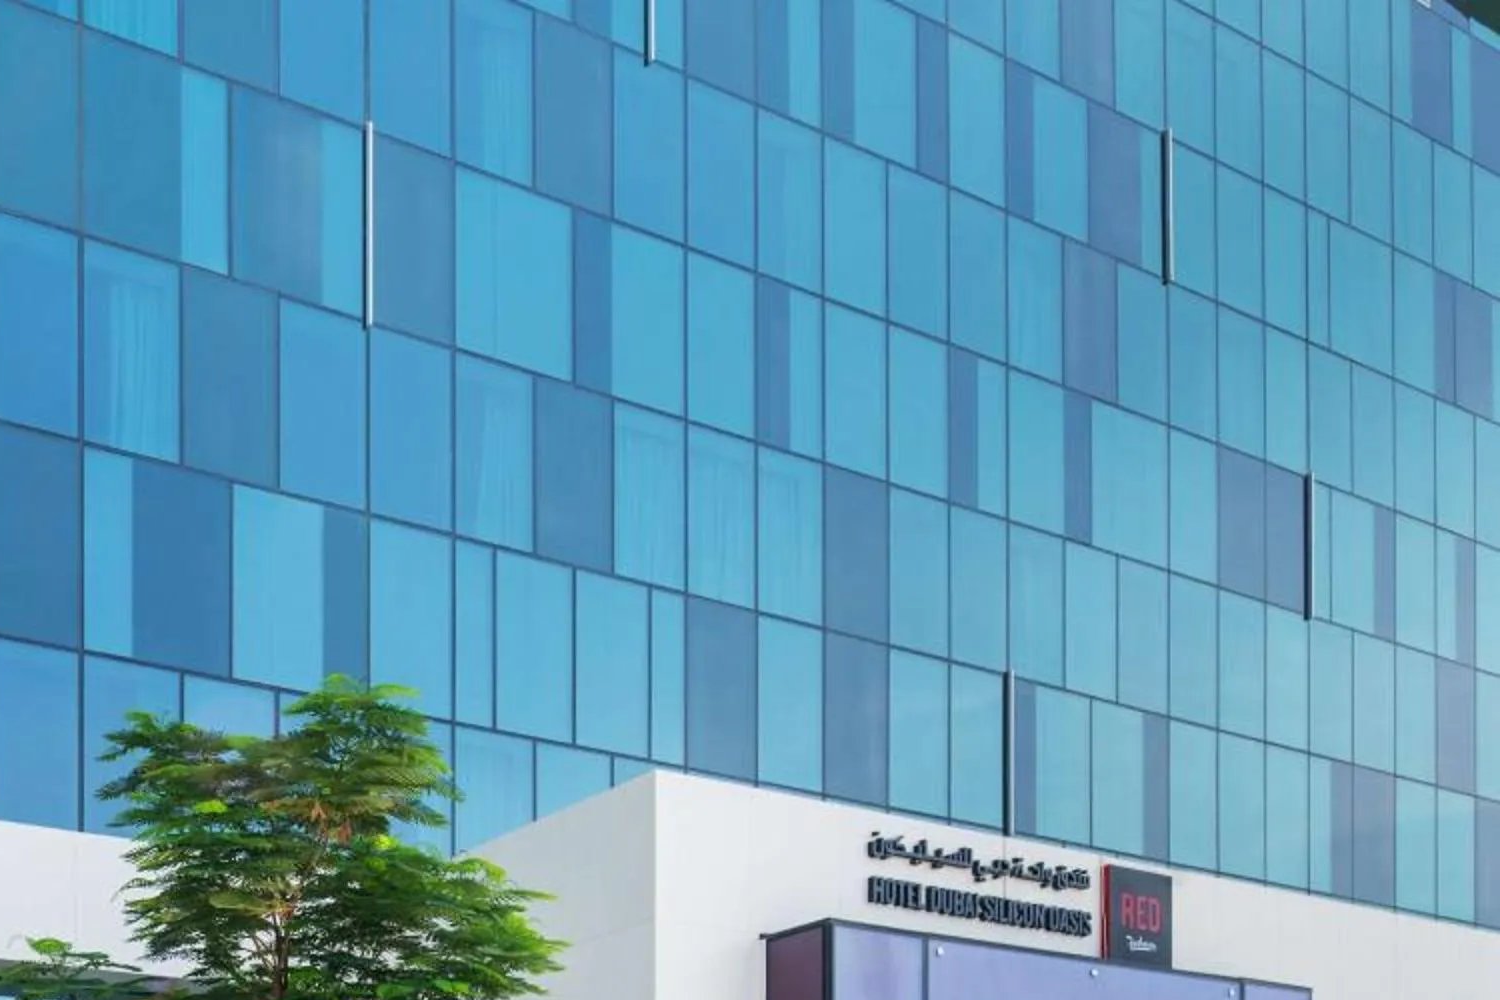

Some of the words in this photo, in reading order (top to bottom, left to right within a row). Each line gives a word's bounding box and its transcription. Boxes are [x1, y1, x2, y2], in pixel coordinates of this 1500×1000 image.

[971, 859, 1010, 882] دبي
[867, 876, 924, 910] HOTEL
[925, 885, 979, 919] DUBAI
[978, 895, 1045, 930] SILICON
[1044, 905, 1092, 937] OASIS
[1121, 893, 1161, 933] RED
